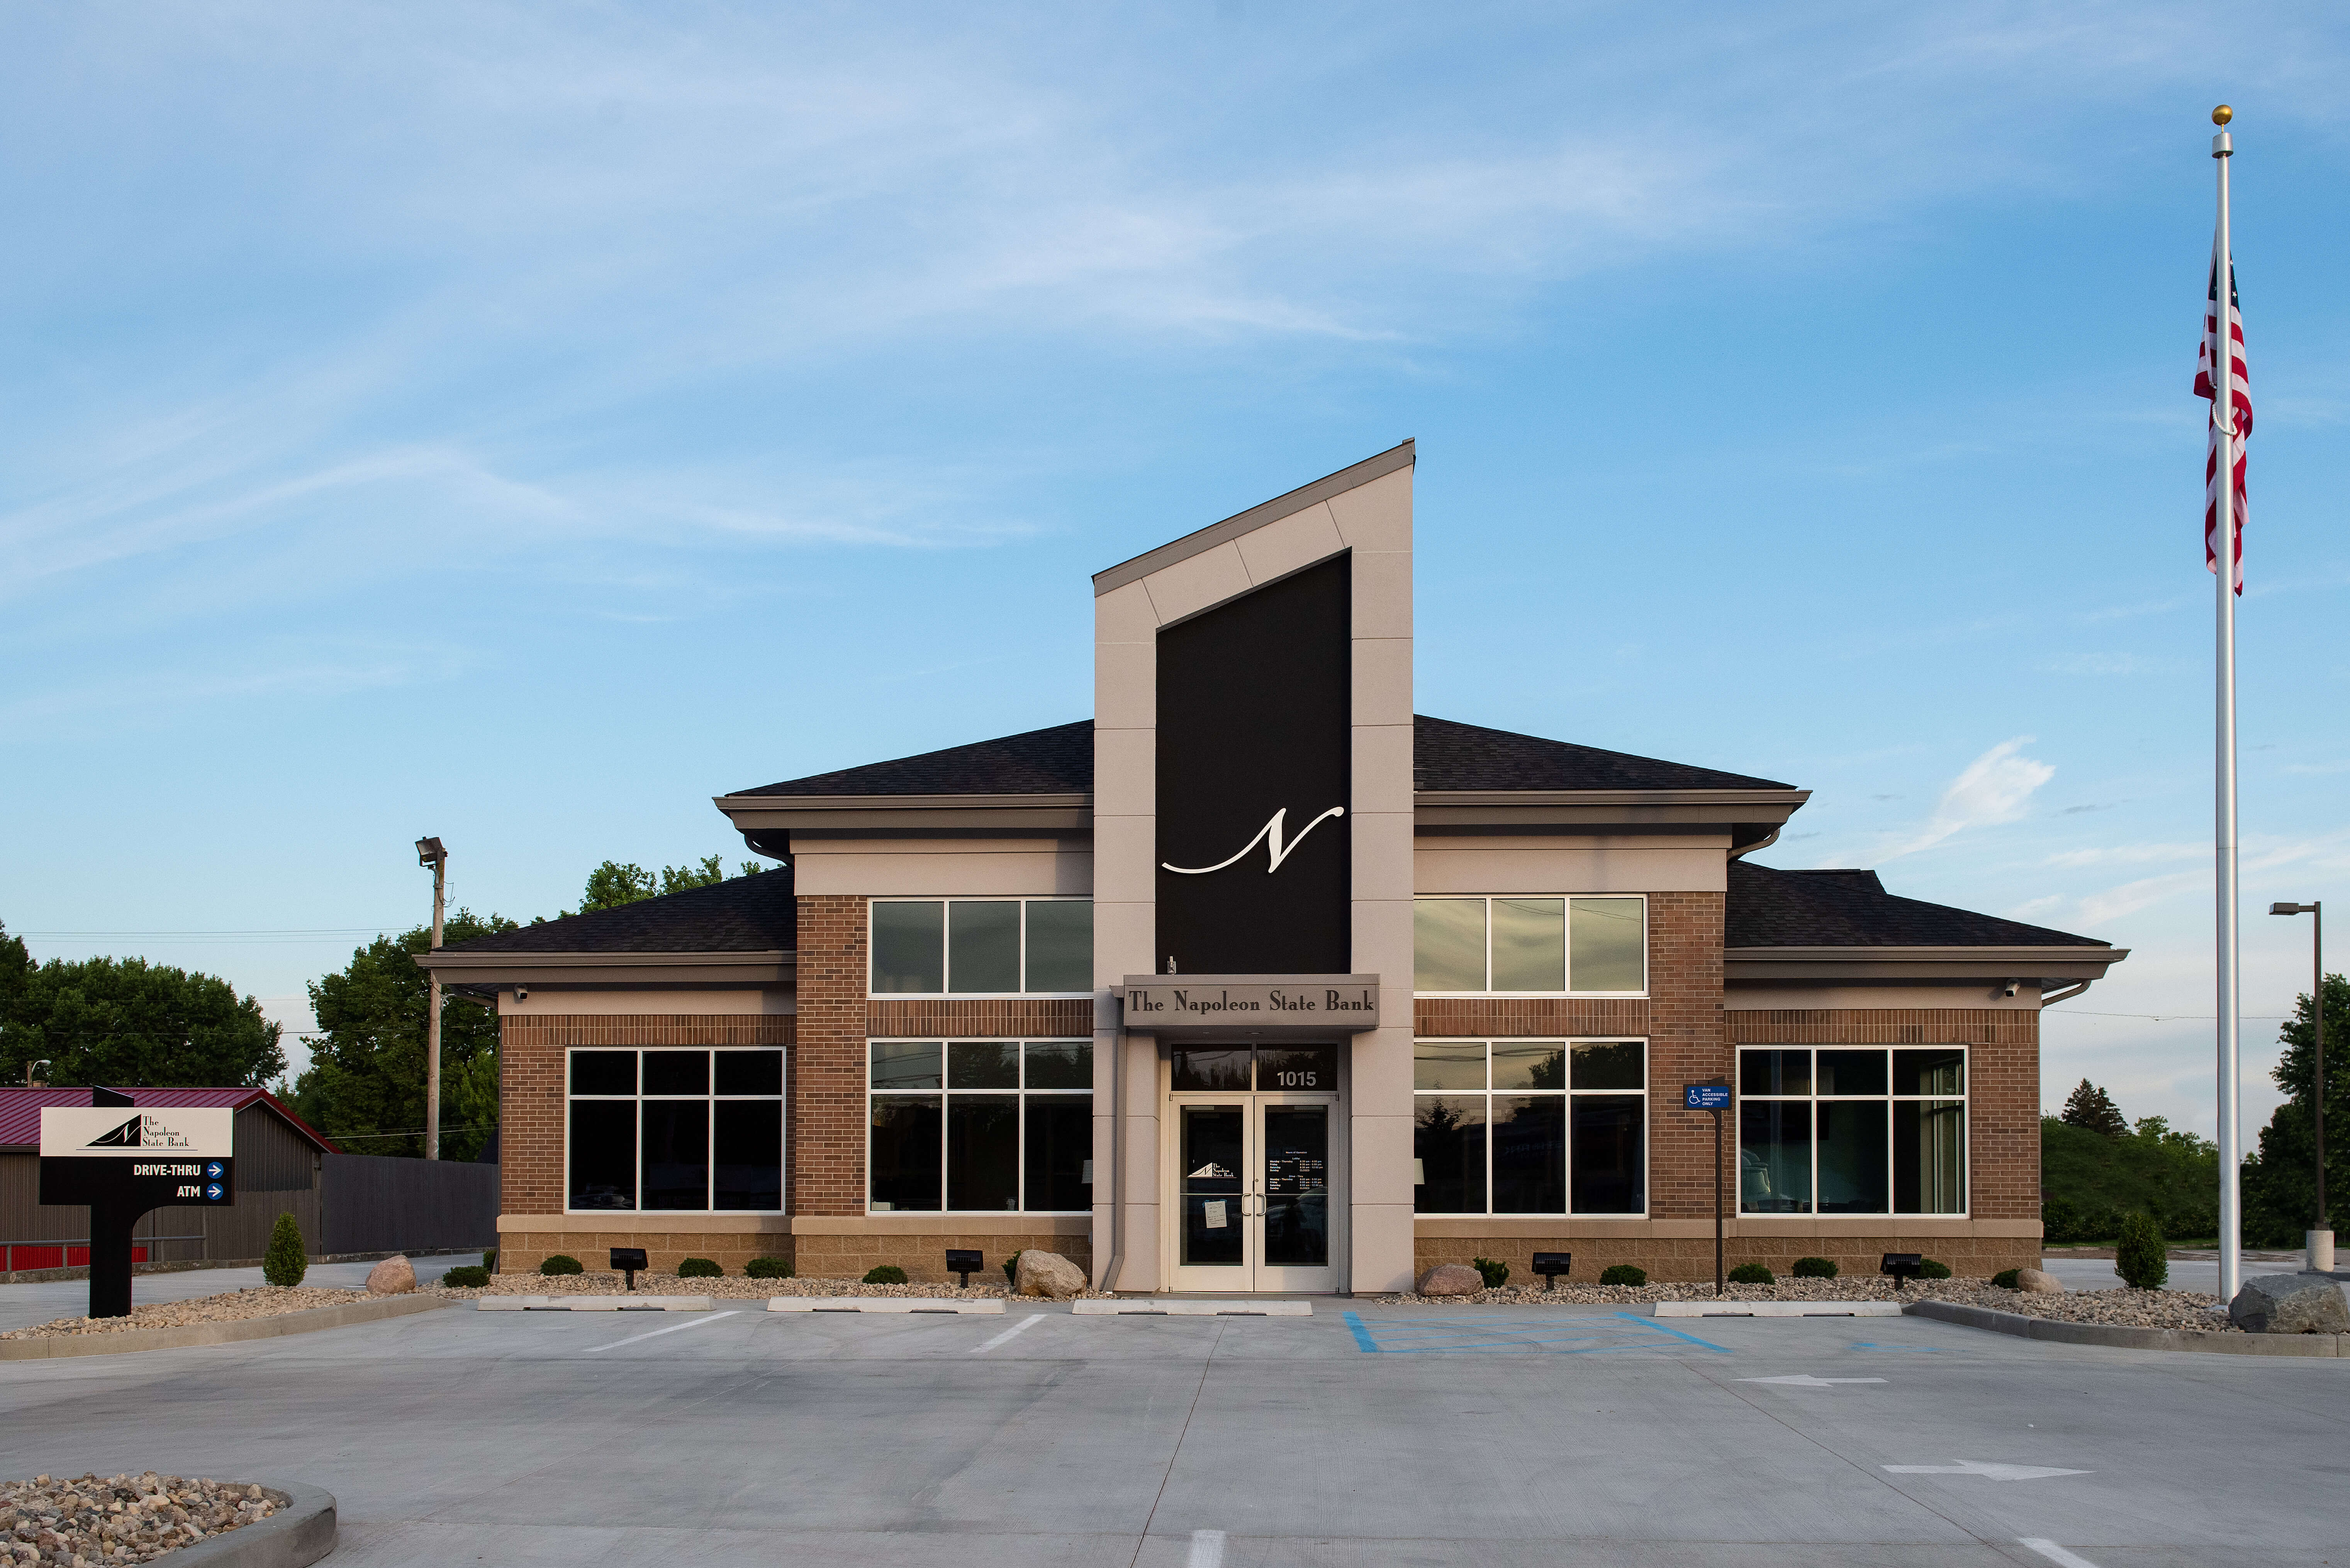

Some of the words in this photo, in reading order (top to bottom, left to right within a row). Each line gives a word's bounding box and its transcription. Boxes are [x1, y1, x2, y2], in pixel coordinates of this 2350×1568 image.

[1162, 807, 1344, 873] N
[1129, 991, 1163, 1011] The
[1174, 990, 1260, 1014] Napoleon
[1270, 990, 1315, 1011] State
[1325, 990, 1374, 1011] Bank
[1277, 1071, 1316, 1086] 1015
[143, 1116, 159, 1126] The
[143, 1127, 180, 1138] Napoleon
[143, 1136, 163, 1146] State
[168, 1137, 189, 1146] Bank
[134, 1165, 200, 1176] DRIVE-THRU
[176, 1186, 200, 1197] ATM
